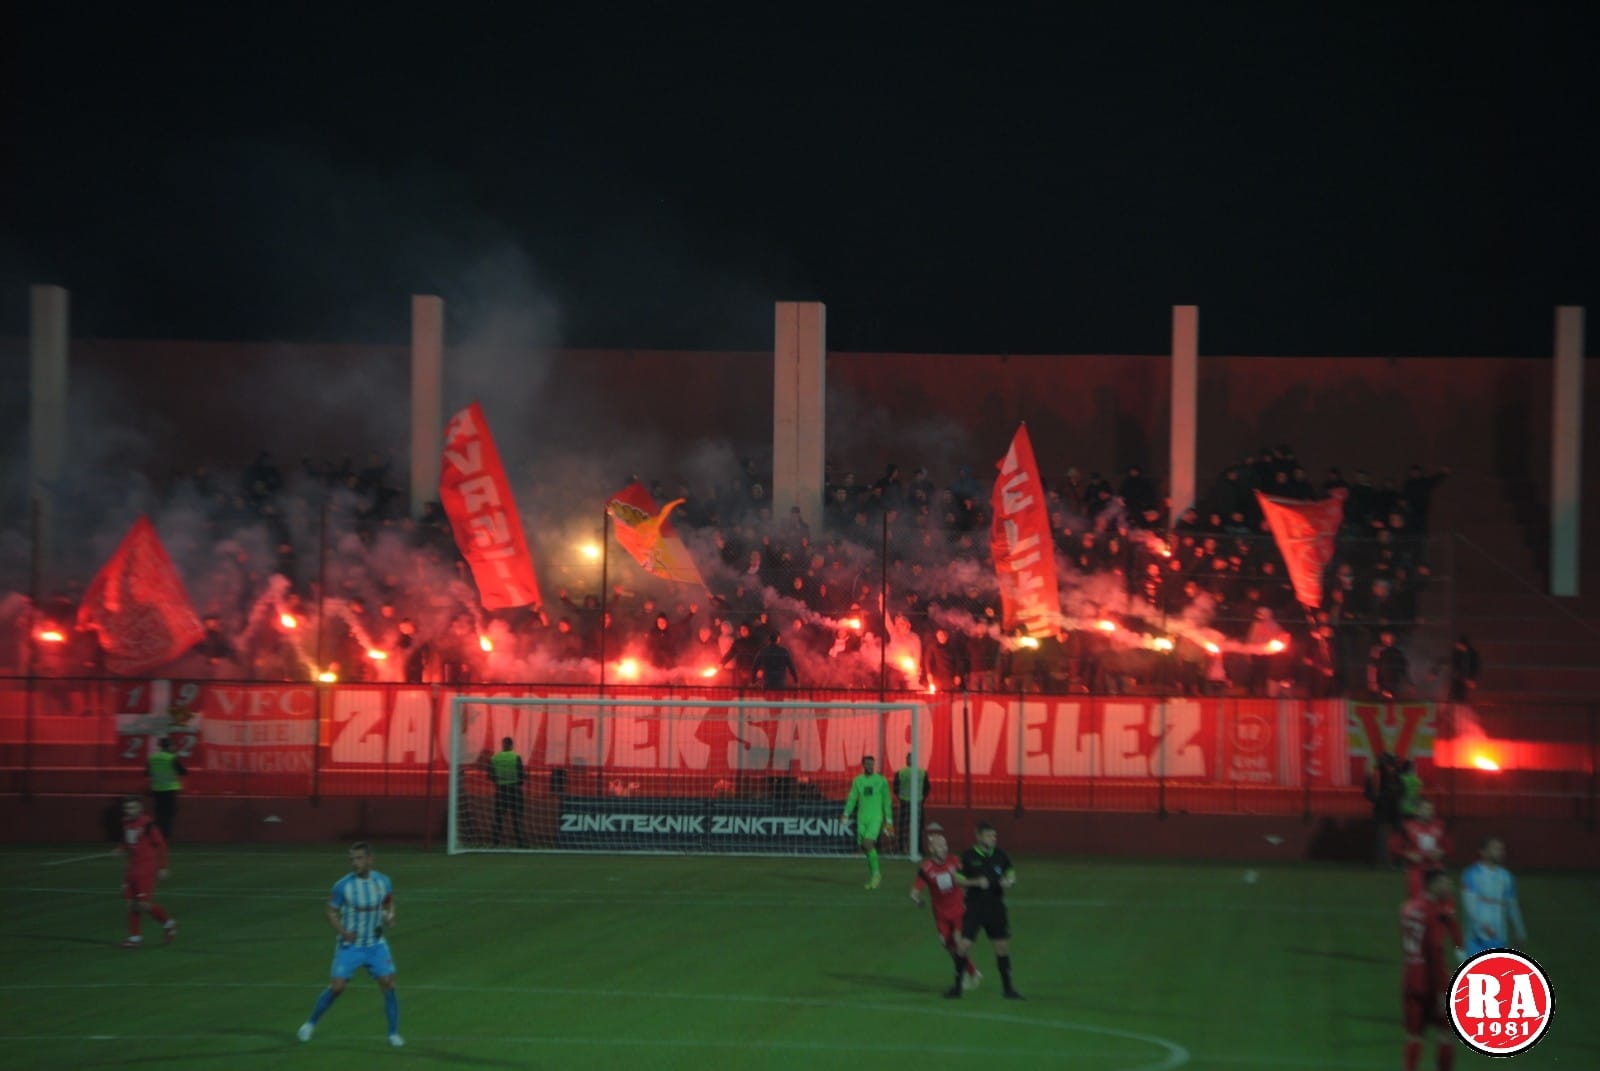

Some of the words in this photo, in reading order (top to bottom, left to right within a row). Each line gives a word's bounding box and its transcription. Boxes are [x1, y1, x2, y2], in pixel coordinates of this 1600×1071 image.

[211, 687, 314, 716] VFC
[229, 723, 290, 744] THE
[727, 698, 934, 773] SAMO
[560, 813, 705, 833] ZINKTEKNIK
[710, 815, 855, 837] ZINKTEKNIK
